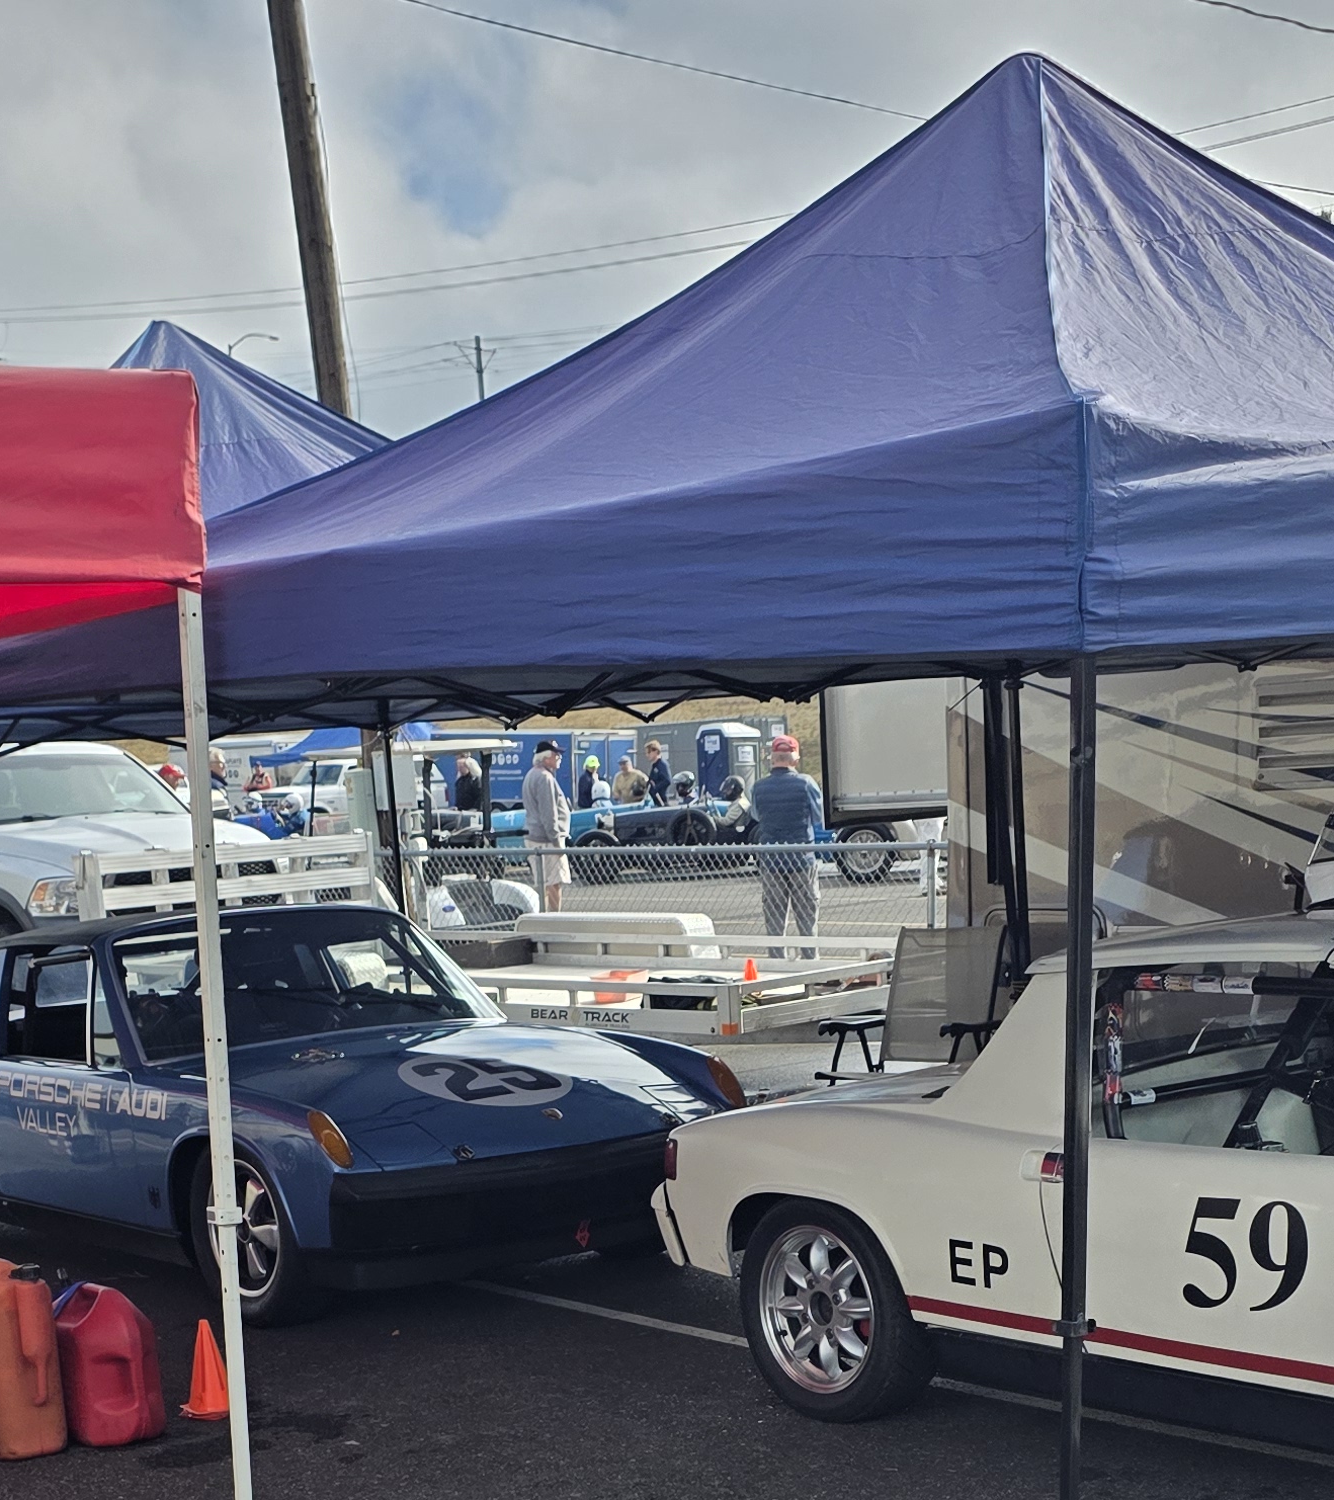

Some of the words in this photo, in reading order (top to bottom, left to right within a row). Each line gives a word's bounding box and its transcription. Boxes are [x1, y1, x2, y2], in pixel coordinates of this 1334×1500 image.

[530, 1008, 569, 1020] BEAR
[583, 1010, 630, 1024] TRACK
[411, 1057, 563, 1102] 25
[17, 1105, 78, 1138] VALLEY
[116, 1086, 168, 1122] AUDI
[948, 1239, 1009, 1289] EP
[1182, 1196, 1309, 1312] 59
